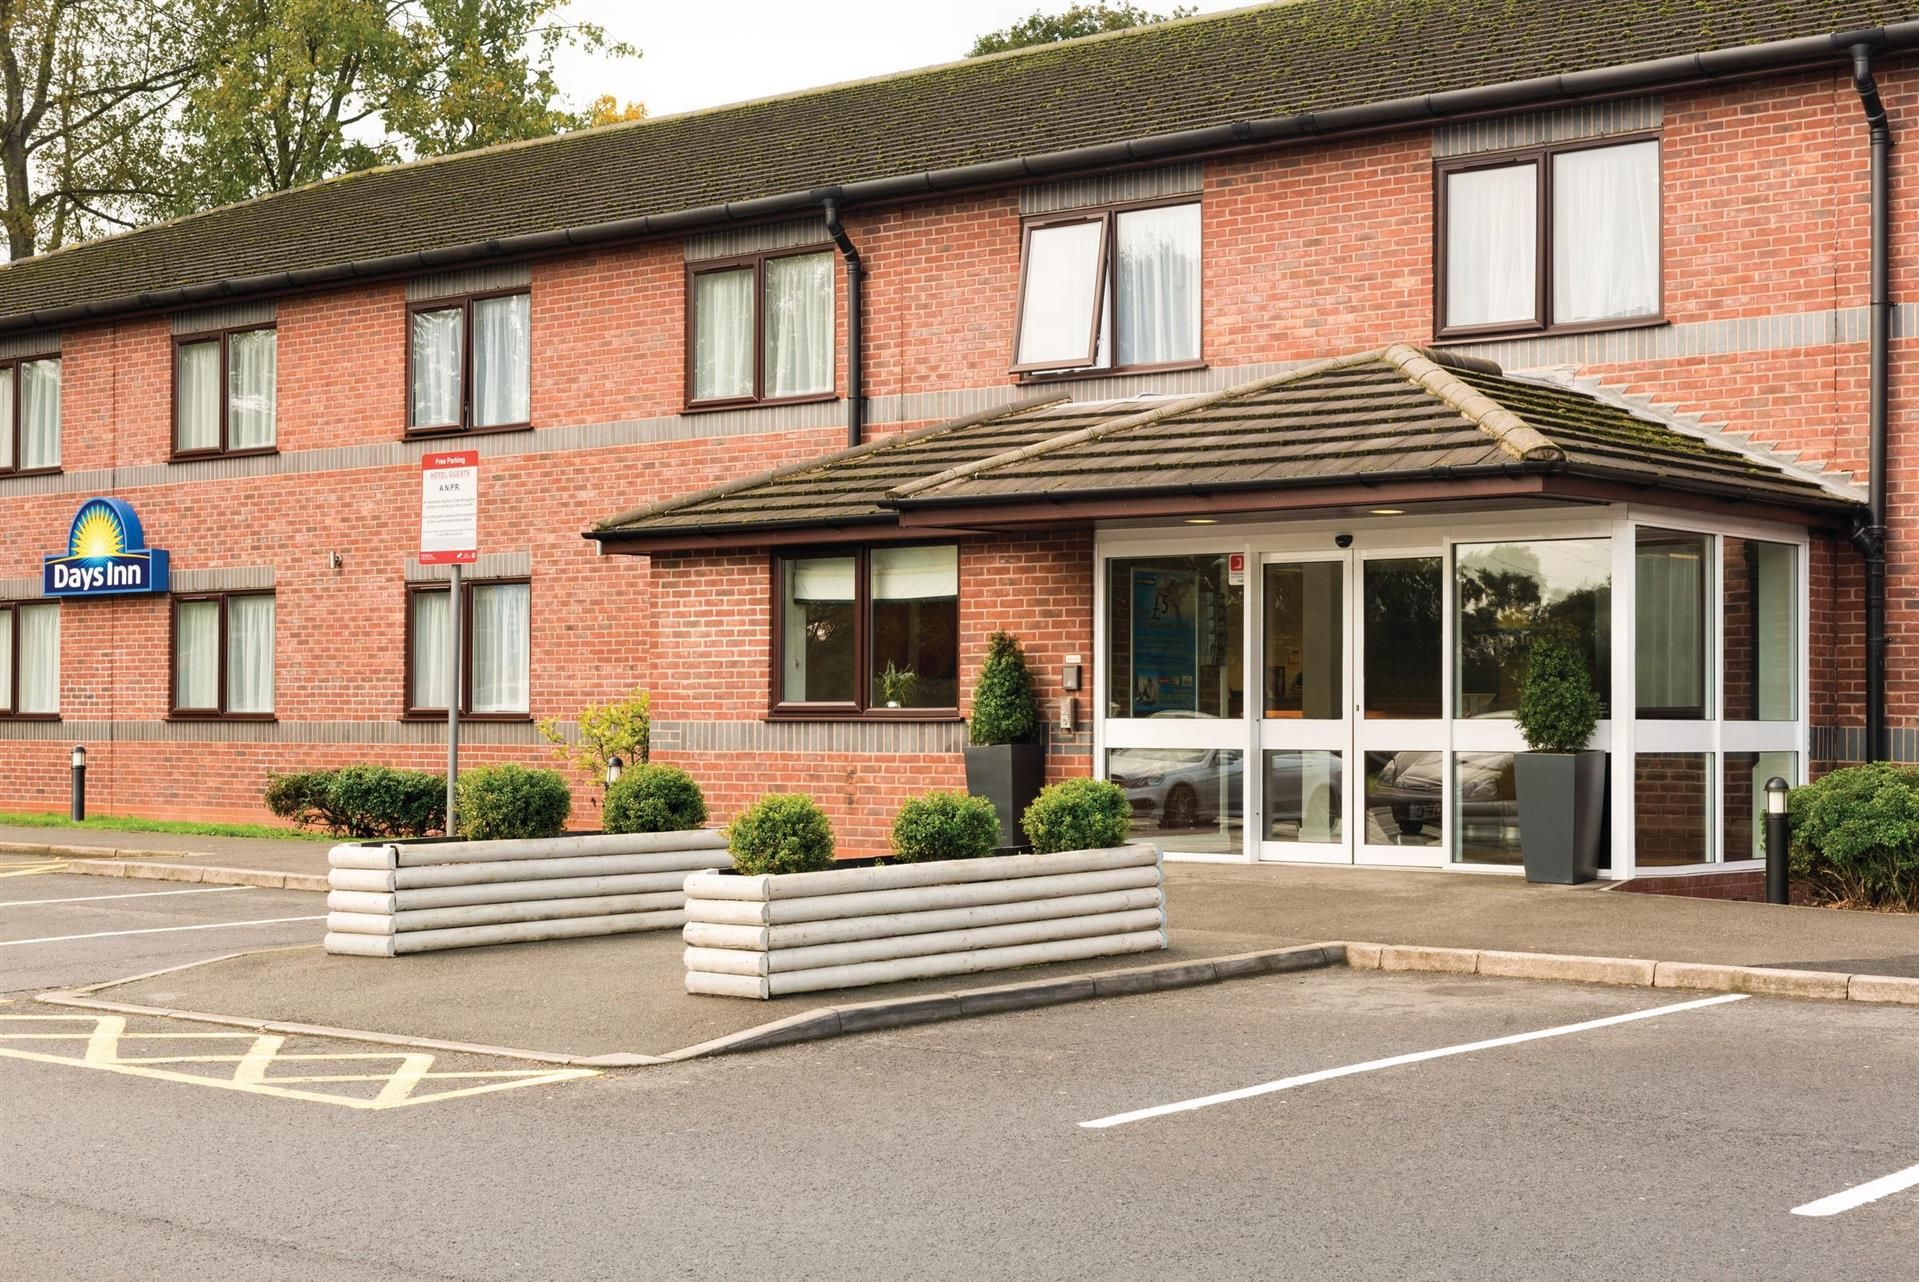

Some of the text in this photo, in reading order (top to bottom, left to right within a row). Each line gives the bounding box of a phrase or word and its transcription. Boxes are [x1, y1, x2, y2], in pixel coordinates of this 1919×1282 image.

[447, 457, 465, 465] Parking
[430, 469, 470, 479] HOTEL GUESTS
[54, 561, 141, 591] Days Inn
[1152, 592, 1169, 620] £5
